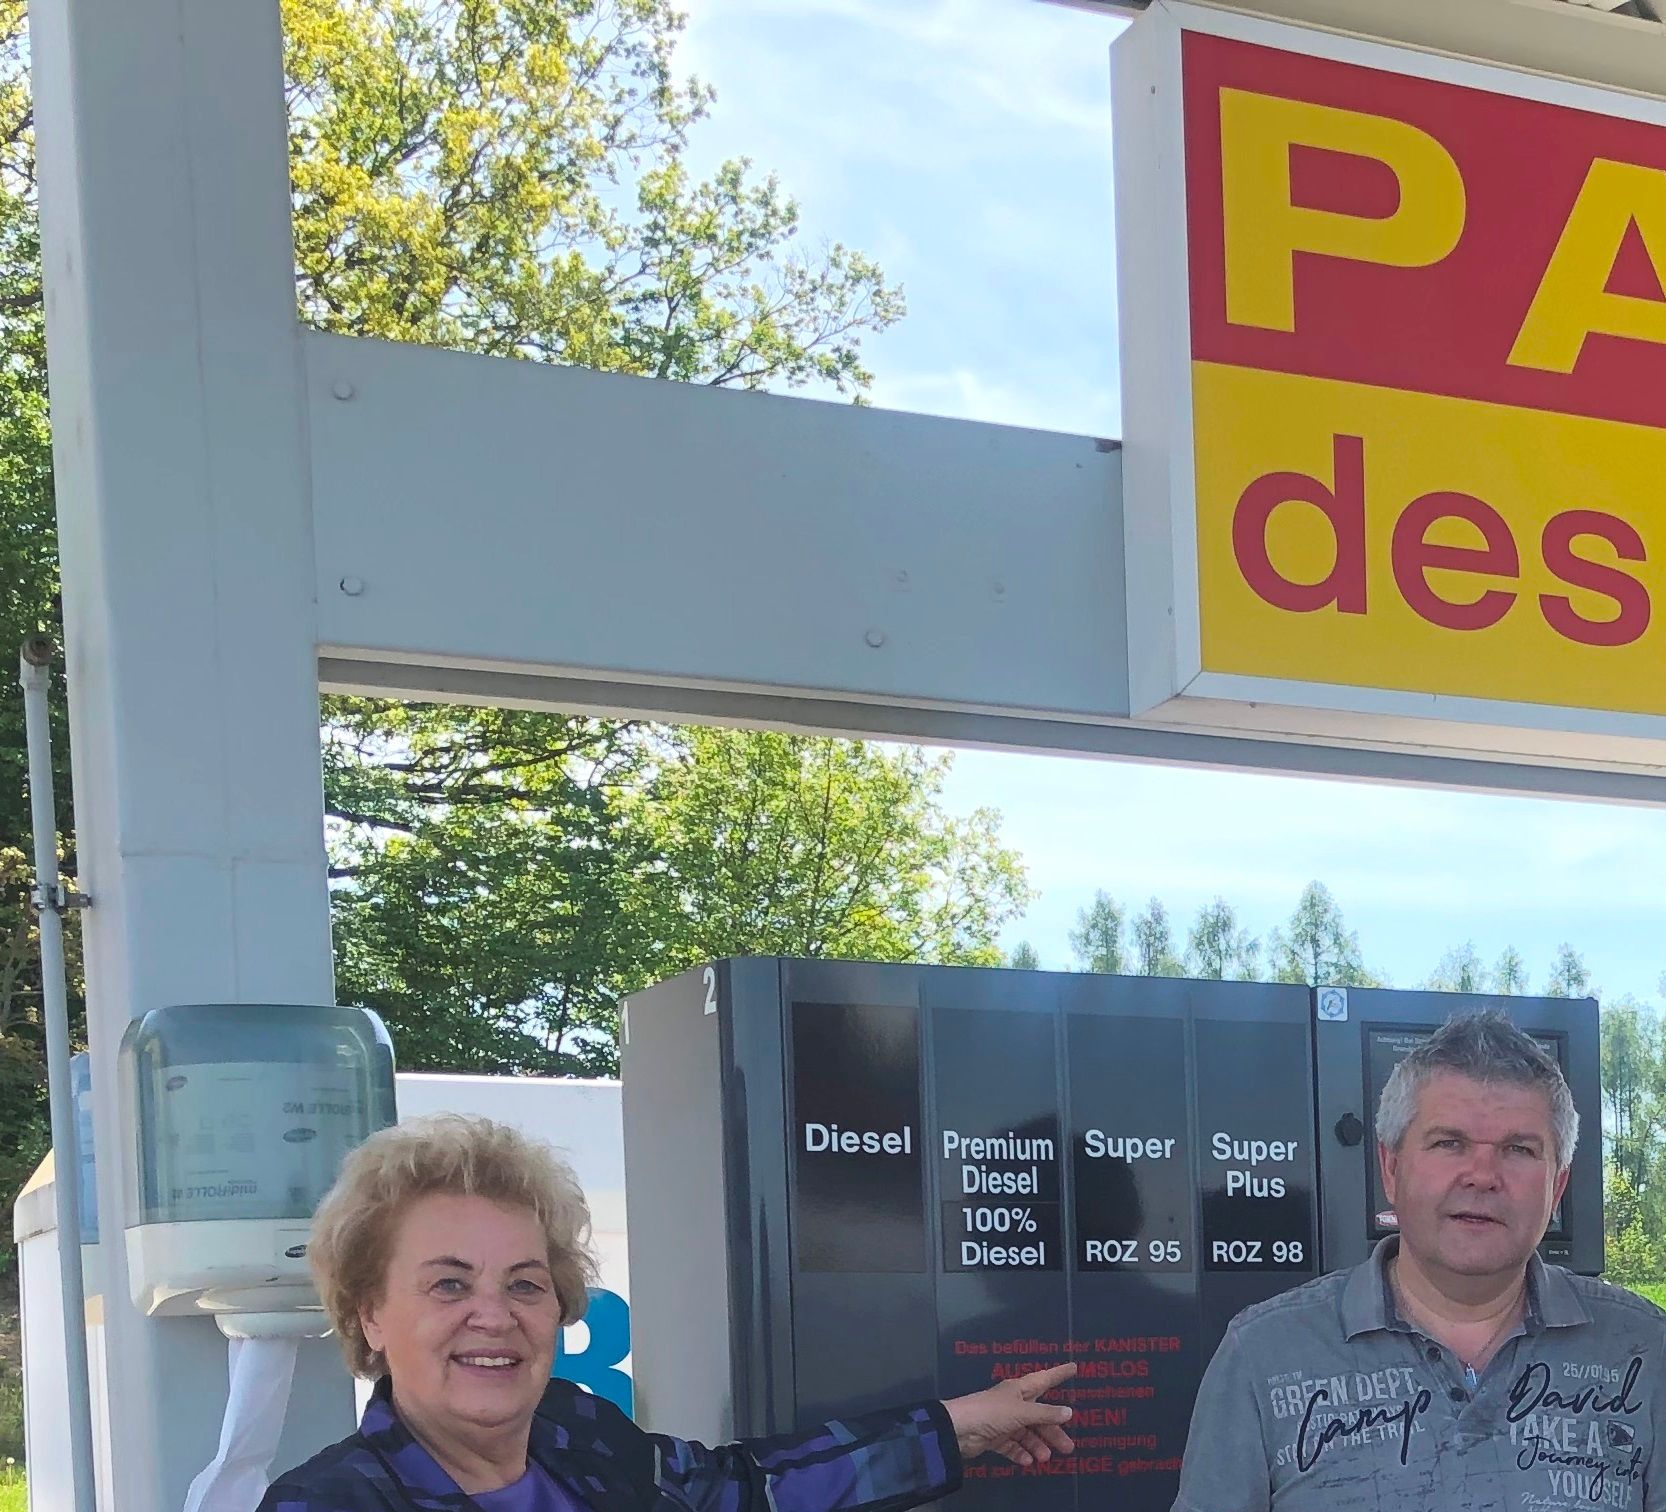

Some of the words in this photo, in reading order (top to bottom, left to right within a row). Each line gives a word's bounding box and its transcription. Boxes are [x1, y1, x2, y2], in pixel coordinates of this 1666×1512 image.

[1232, 434, 1651, 647] des
[703, 967, 717, 1015] 2
[805, 1123, 912, 1154] Diesel
[942, 1130, 1054, 1161] Premium
[1084, 1129, 1175, 1163] Super
[1212, 1132, 1298, 1167] Super
[962, 1165, 1038, 1194] Diesel
[1226, 1171, 1286, 1198] Plus
[962, 1207, 1037, 1233] 100%
[961, 1242, 1045, 1266] Diesel
[1086, 1240, 1139, 1263] ROZ
[1149, 1241, 1182, 1263] 95
[1212, 1241, 1262, 1263] ROZ
[1272, 1241, 1304, 1263] 98
[1095, 1336, 1181, 1353] KANISTER
[1270, 1376, 1349, 1419] GREEN
[1505, 1356, 1643, 1423] David
[1297, 1389, 1432, 1473] Camp
[1509, 1413, 1578, 1453] TAKE
